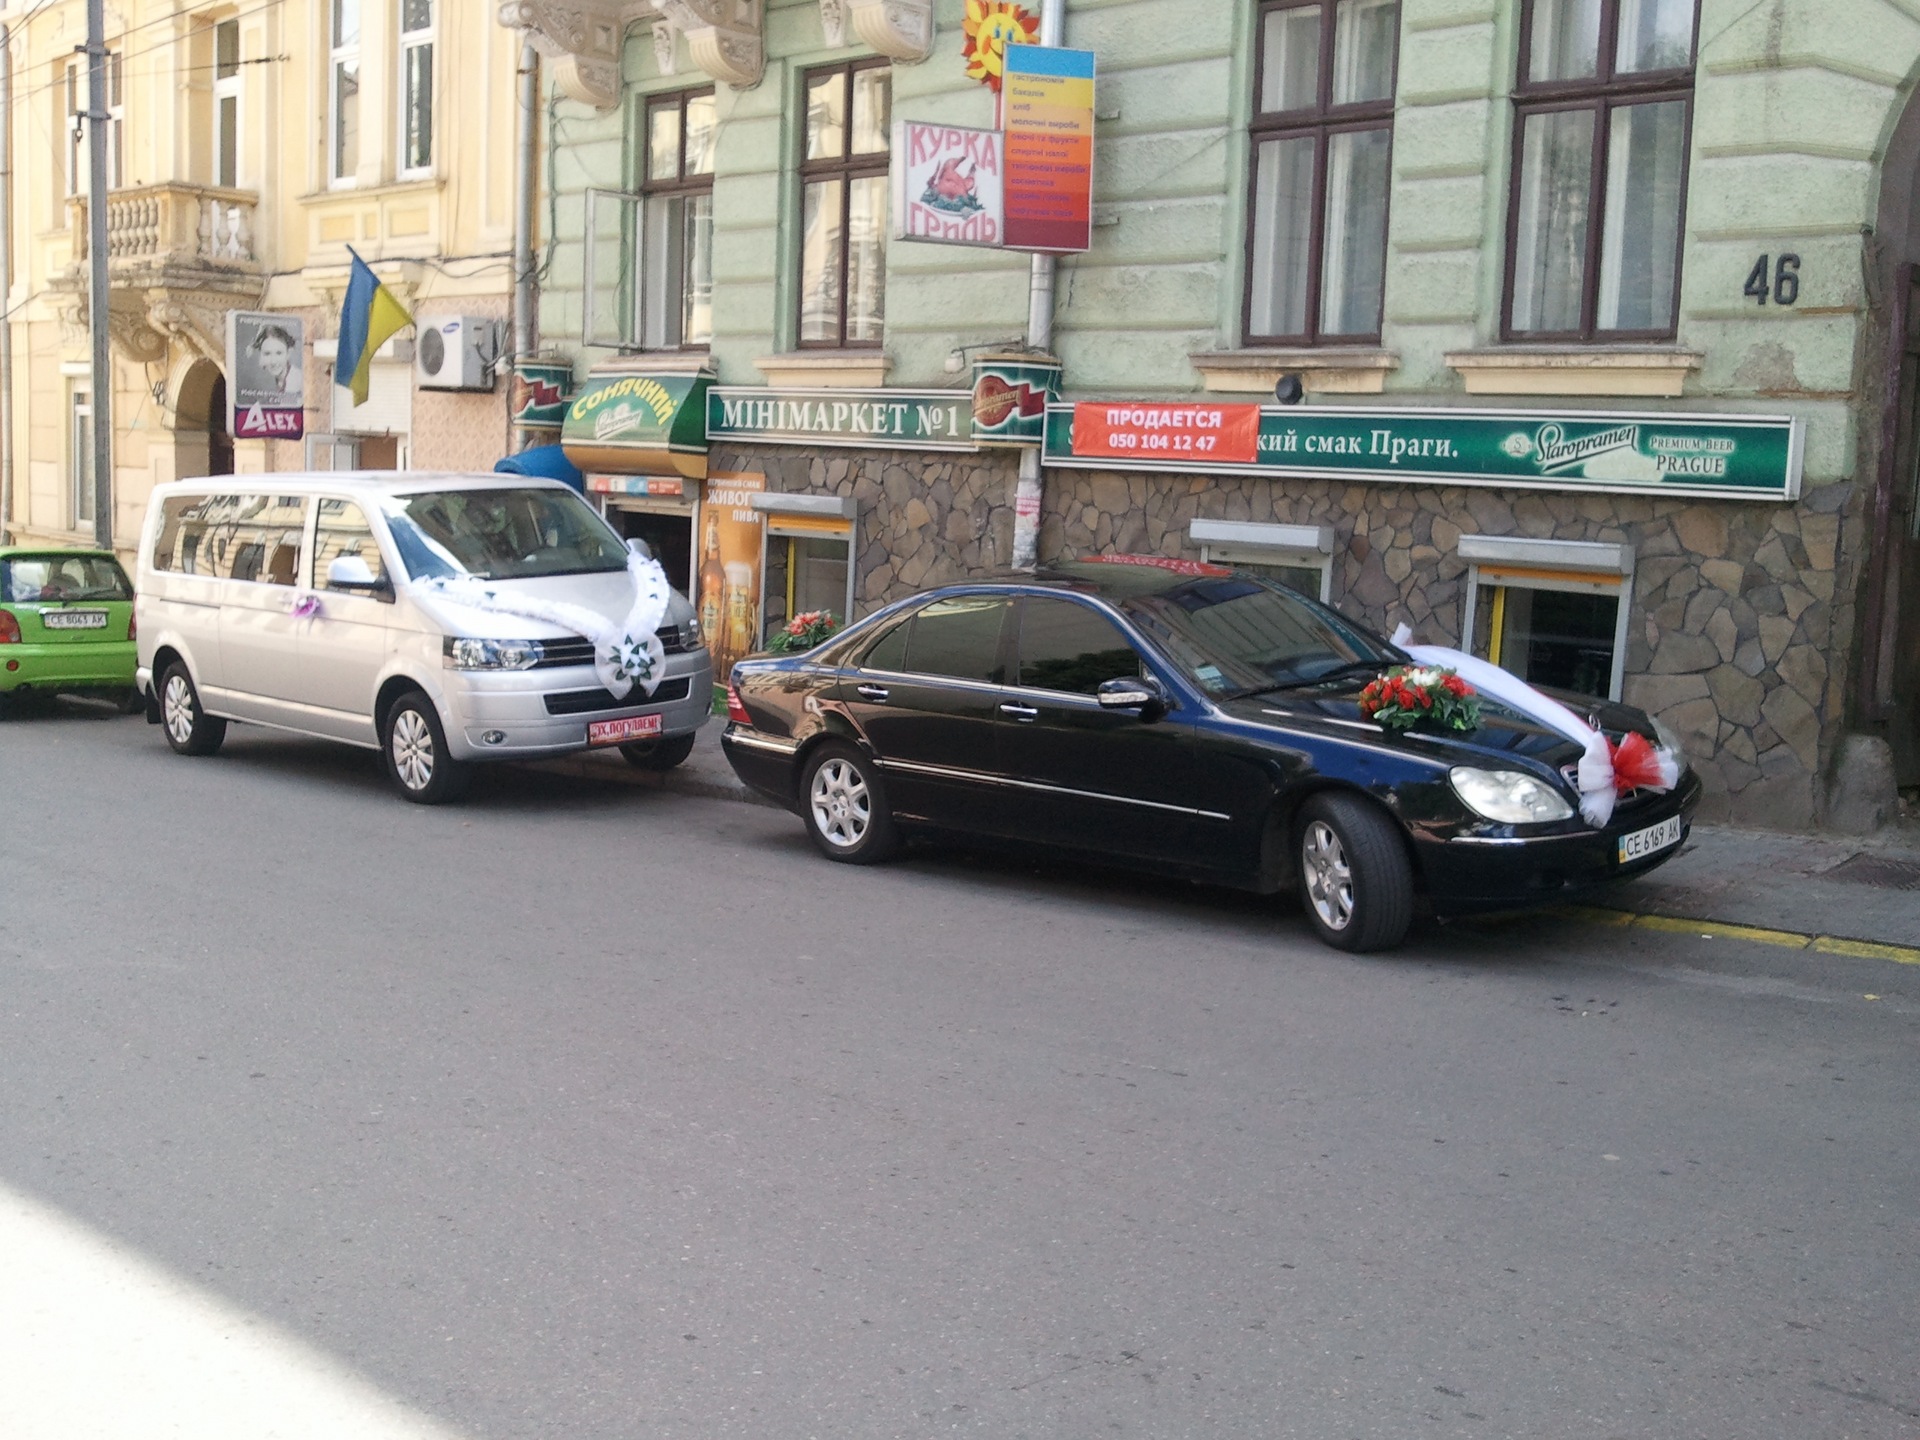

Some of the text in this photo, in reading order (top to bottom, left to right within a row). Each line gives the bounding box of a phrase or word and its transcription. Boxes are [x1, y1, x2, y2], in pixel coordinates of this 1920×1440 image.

[909, 125, 998, 176] КУРКА
[1744, 253, 1800, 305] 46
[572, 378, 678, 426] СОНЯЧНИЙ
[721, 399, 908, 435] МІНІМАРКЕТ
[1107, 410, 1222, 430] ПРОДАЕТСЯ
[1109, 433, 1216, 450] 050 104 12 47
[1256, 429, 1458, 463] кий смак Праги.
[1535, 424, 1638, 471] Staropramen
[1650, 436, 1733, 451] PREMIUM BEER
[1656, 454, 1724, 474] PRAGUE
[706, 489, 751, 507] ЖИВОГ
[732, 509, 760, 524] ПИВА
[1627, 819, 1679, 856] CE 6169 AK
